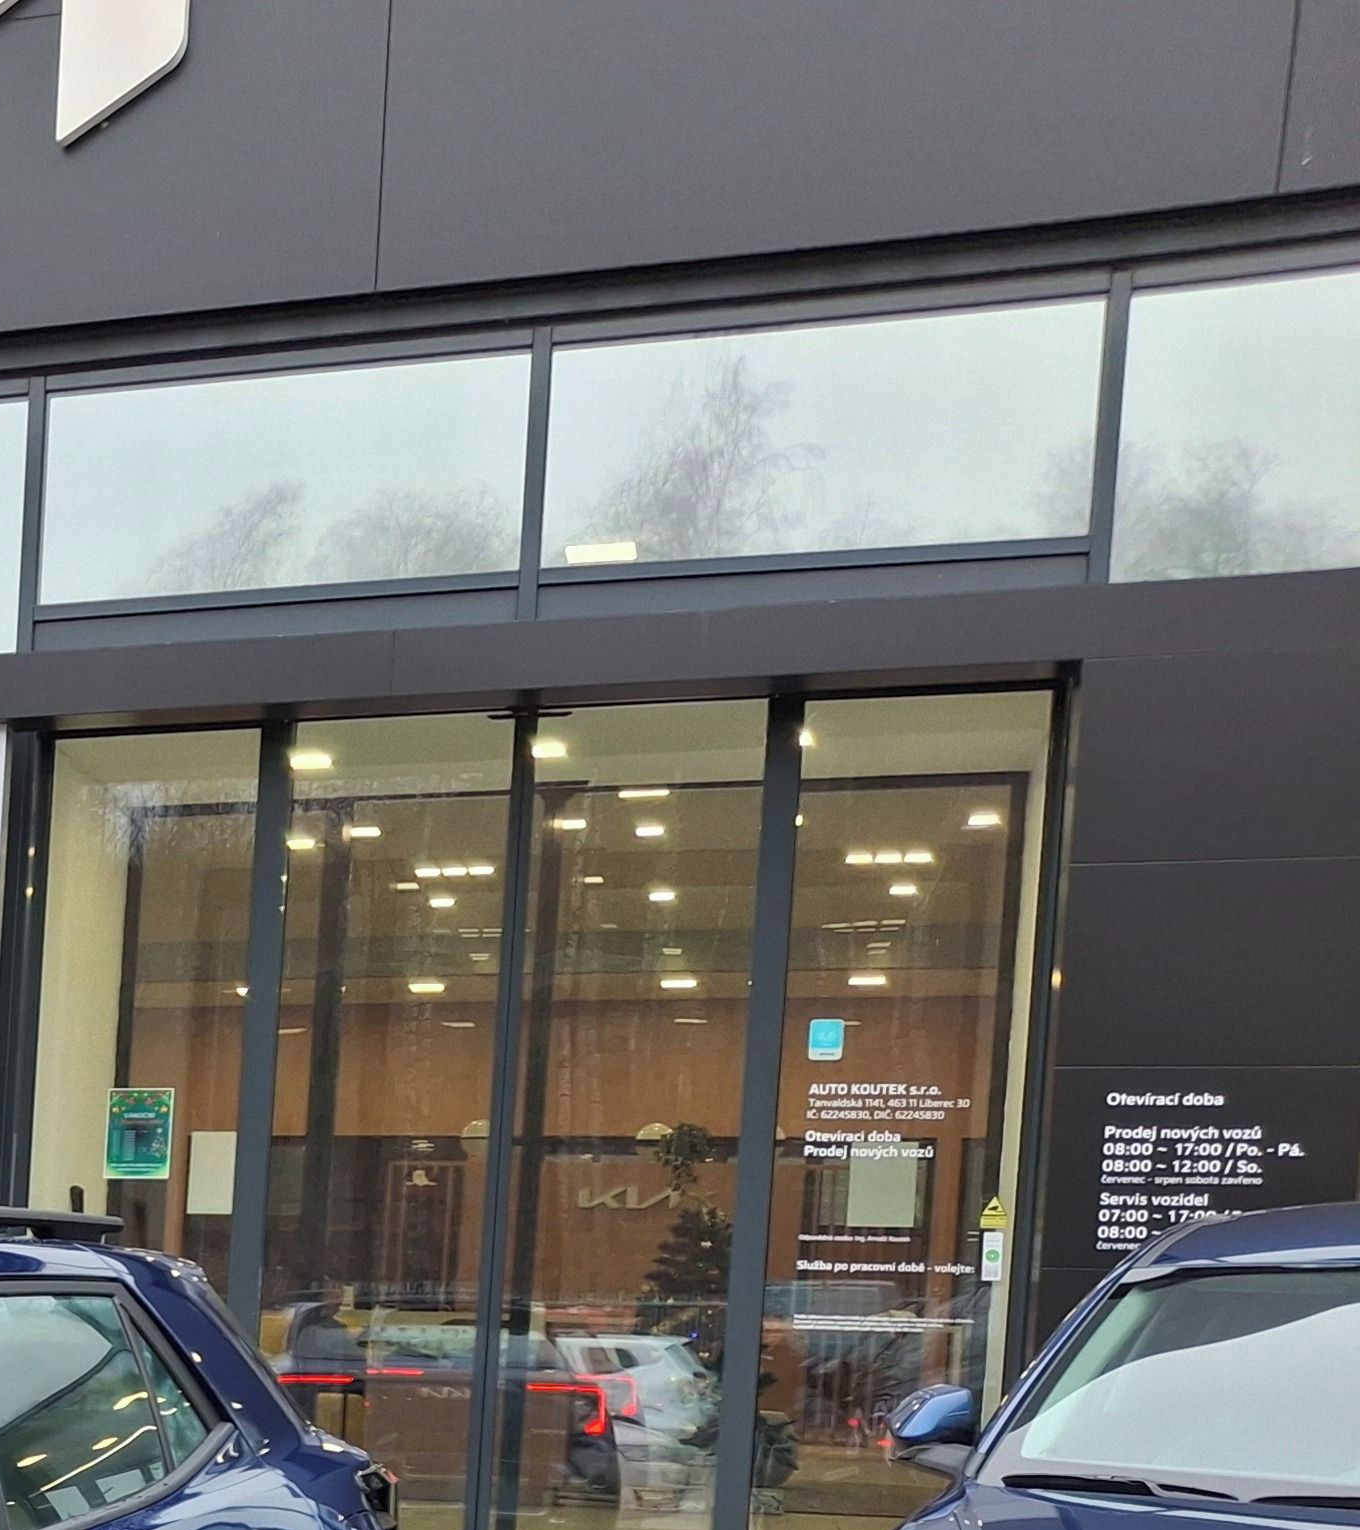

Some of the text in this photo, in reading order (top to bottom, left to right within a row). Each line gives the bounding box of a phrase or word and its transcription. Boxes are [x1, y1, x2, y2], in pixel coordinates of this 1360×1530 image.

[808, 1083, 942, 1096] AUTO KOUTEK s.r.o.
[886, 1099, 907, 1108] 463
[919, 1099, 955, 1109] Liberec
[1106, 1092, 1225, 1106] Otevírací doba
[867, 1131, 901, 1143] doba
[1104, 1126, 1262, 1142] Prodej nových vozů
[804, 1145, 934, 1160] Prodej nových vozů
[1102, 1143, 1154, 1156] 08:00
[1174, 1143, 1222, 1156] 17:00
[1278, 1143, 1305, 1157] Pá.
[1101, 1159, 1152, 1173] 08:00
[1172, 1160, 1221, 1173] 12:00
[1236, 1160, 1263, 1174] So.
[1154, 1176, 1183, 1187] srpen
[1185, 1175, 1219, 1185] sobota
[1099, 1192, 1210, 1207] Servis vozidel
[1098, 1209, 1148, 1222] 07:00
[1097, 1226, 1148, 1239] 08:00
[796, 1260, 832, 1272] Služba
[834, 1262, 847, 1273] po
[850, 1261, 896, 1273] pracovní
[898, 1261, 925, 1273] době
[934, 1263, 976, 1277] volejte:
